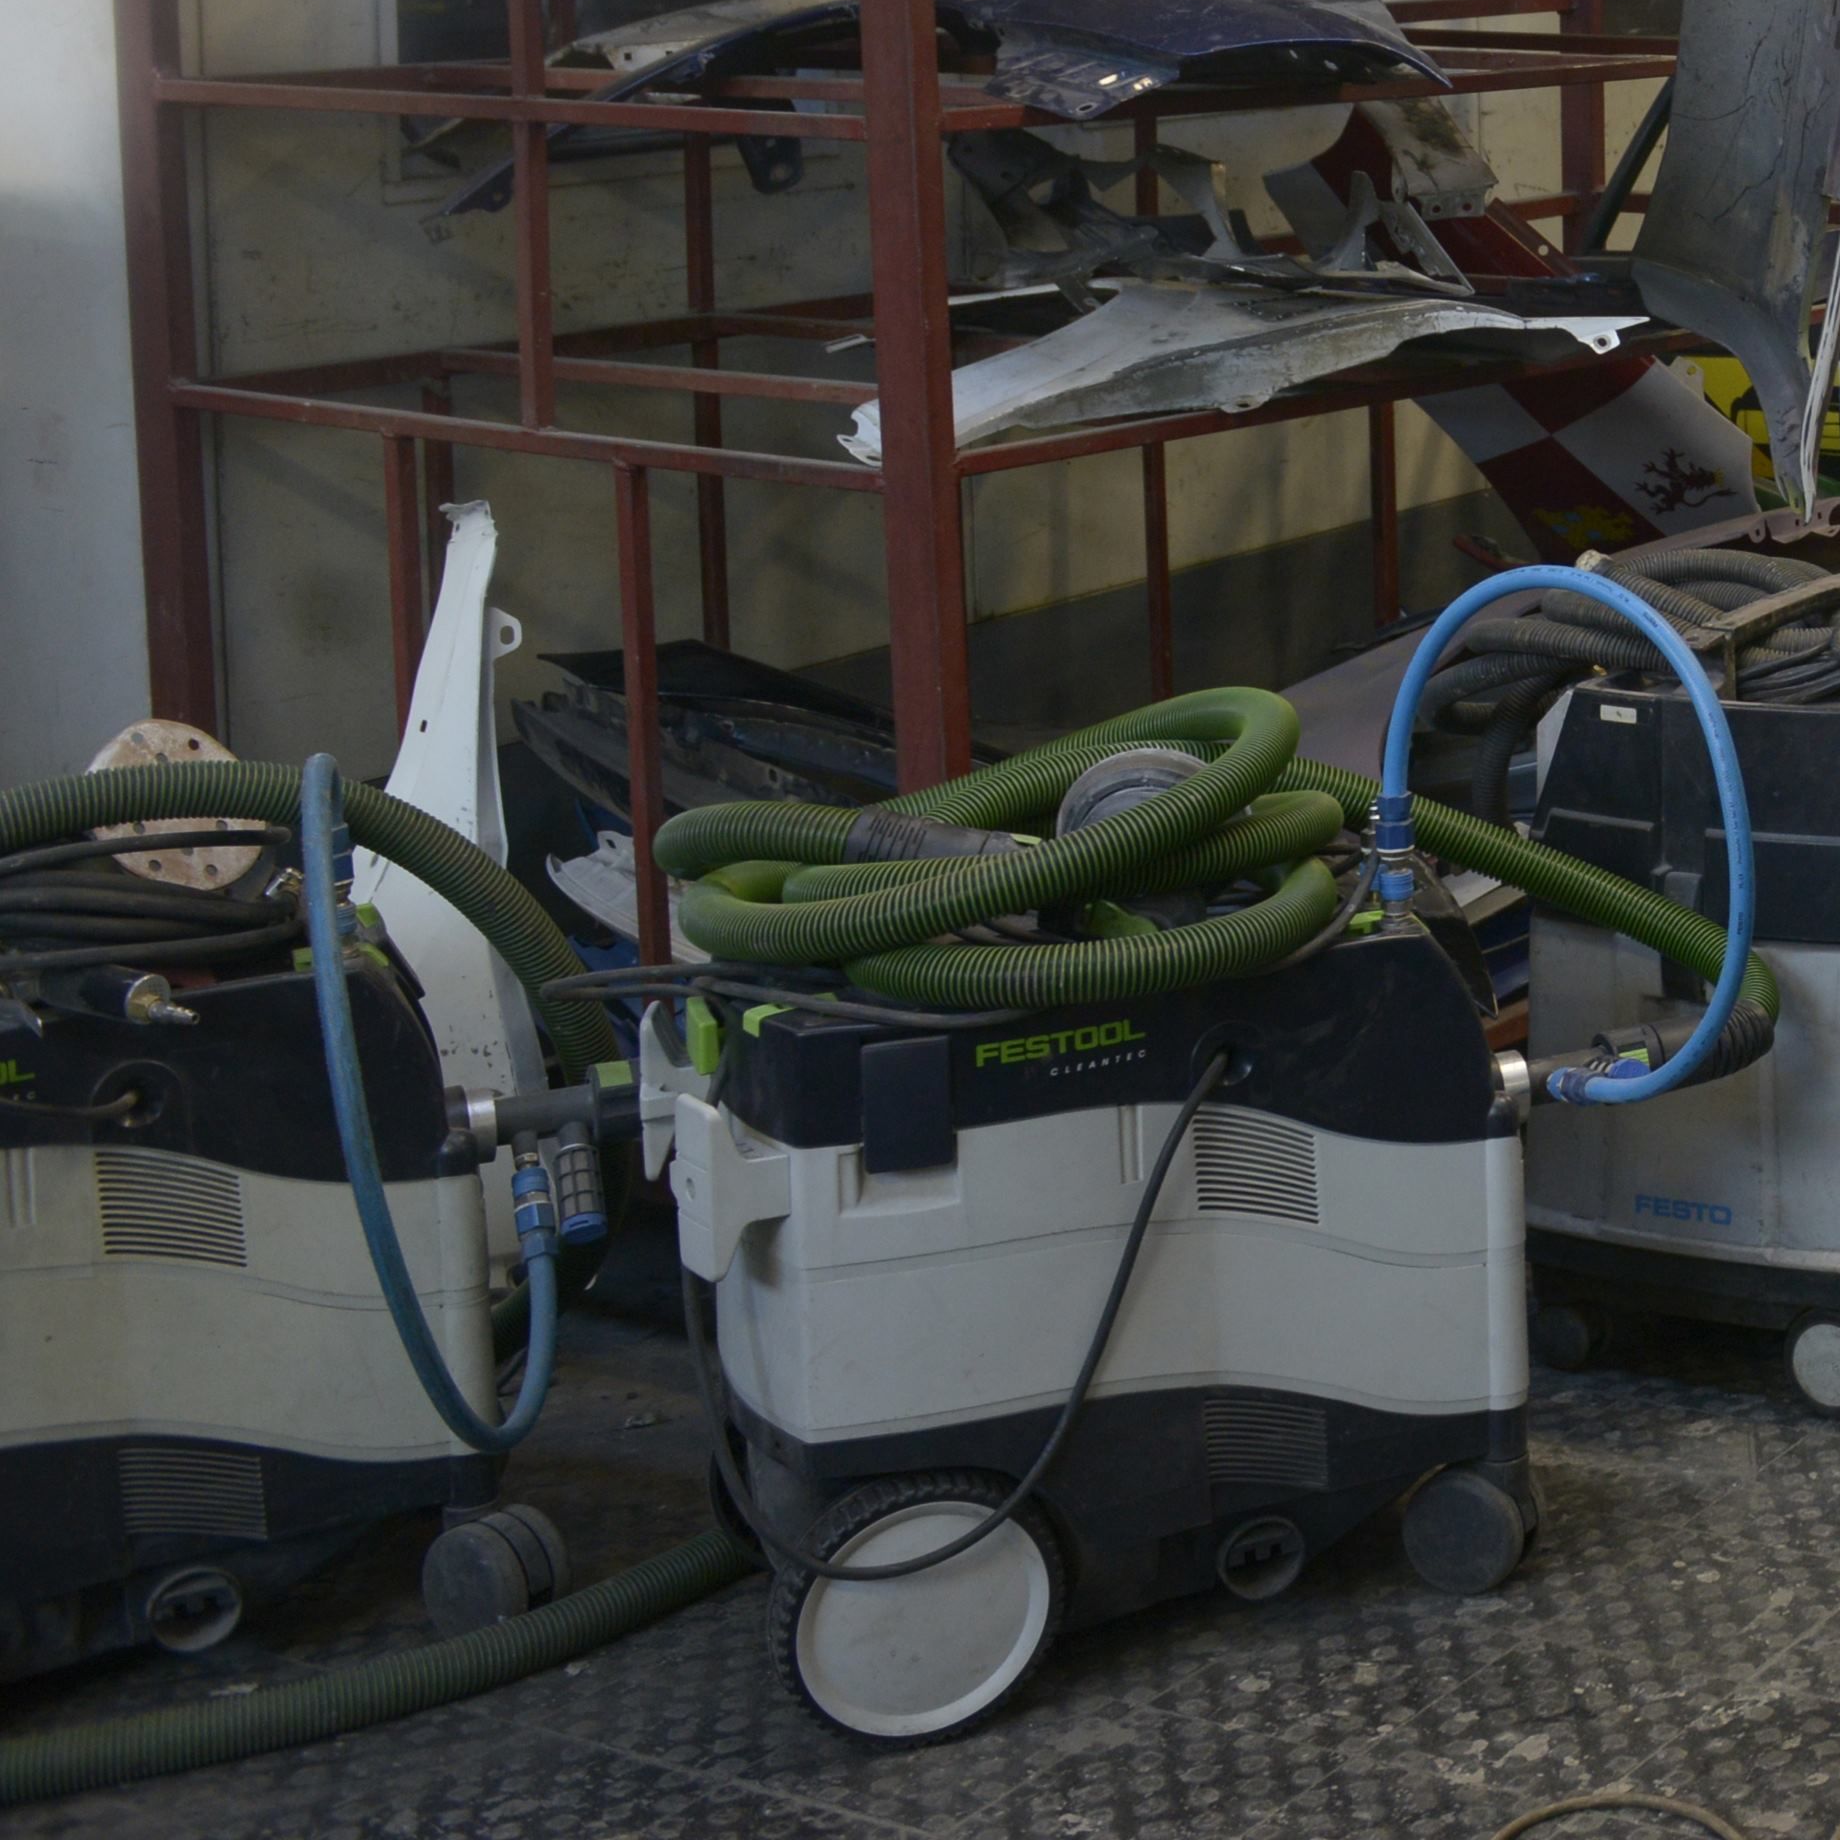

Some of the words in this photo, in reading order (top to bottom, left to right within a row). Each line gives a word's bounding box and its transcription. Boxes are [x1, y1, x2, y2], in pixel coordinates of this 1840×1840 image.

[975, 1019, 1147, 1068] FESTOOL
[1049, 1049, 1147, 1077] CLEANTEC
[1635, 1193, 1733, 1226] FESTO
